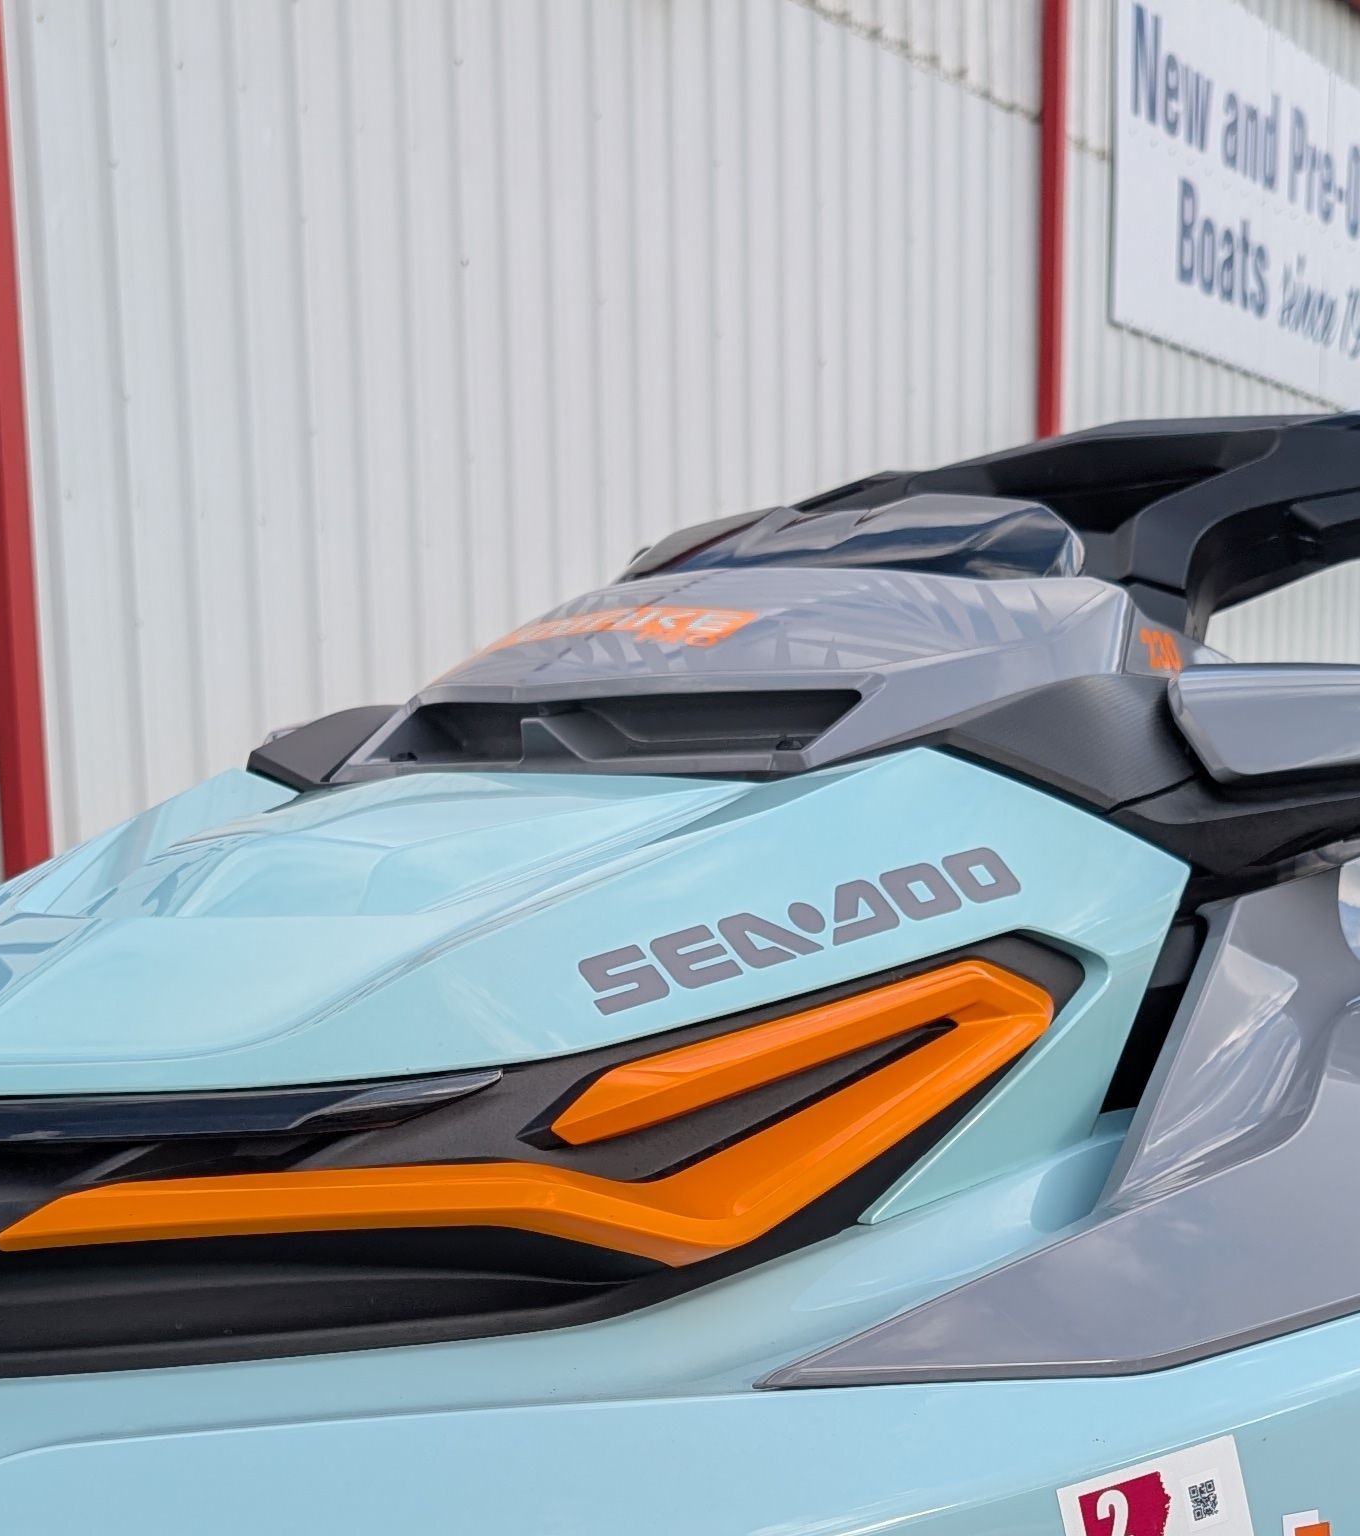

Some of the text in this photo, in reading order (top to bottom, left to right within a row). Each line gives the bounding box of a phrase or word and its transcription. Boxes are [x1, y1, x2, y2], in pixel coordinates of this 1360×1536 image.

[1129, 3, 1213, 153] New
[1222, 91, 1281, 193] and
[1174, 176, 1270, 318] Boats
